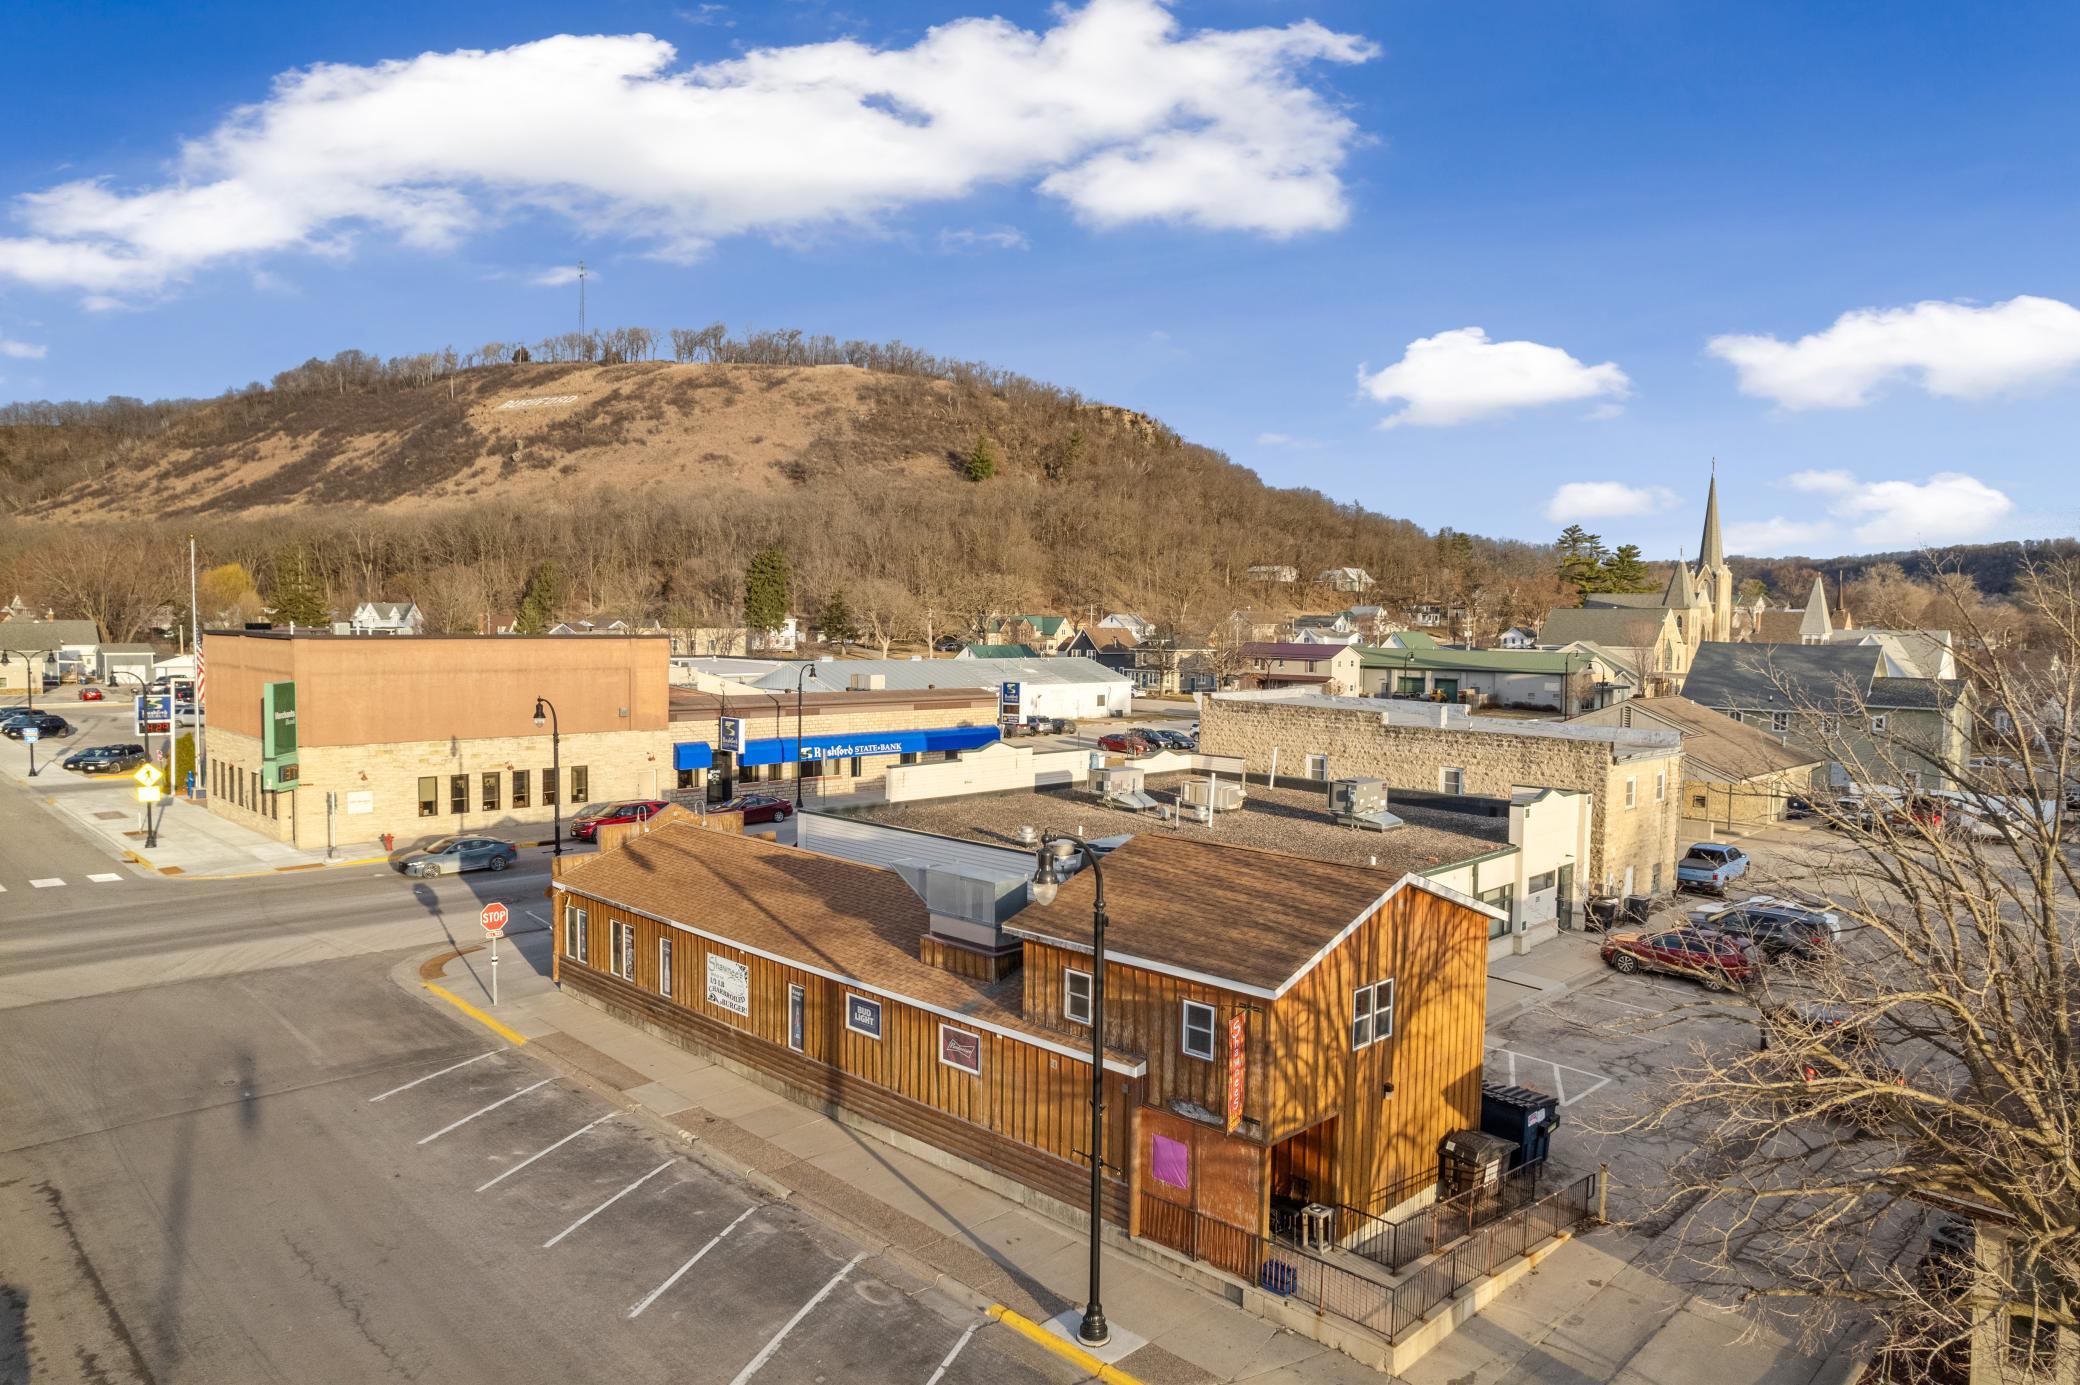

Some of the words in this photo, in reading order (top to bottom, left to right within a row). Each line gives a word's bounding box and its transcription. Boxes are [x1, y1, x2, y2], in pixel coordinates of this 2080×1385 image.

[814, 744, 854, 758] Rshford
[483, 910, 506, 924] STOP
[857, 1005, 872, 1017] BUD
[854, 1012, 874, 1026] LIGHT
